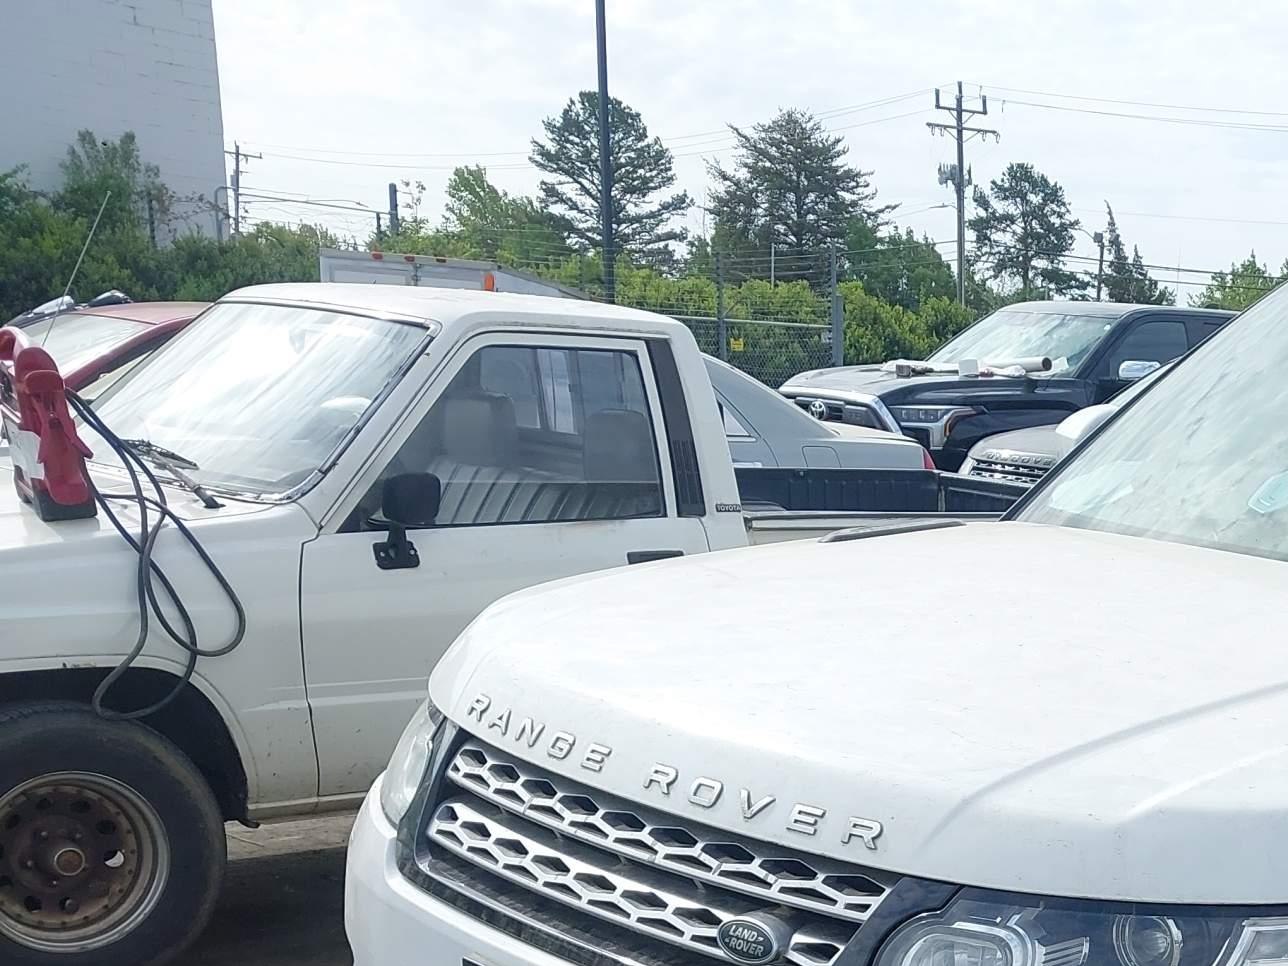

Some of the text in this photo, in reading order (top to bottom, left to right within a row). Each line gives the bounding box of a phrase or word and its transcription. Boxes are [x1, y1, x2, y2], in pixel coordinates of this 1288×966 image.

[716, 504, 741, 512] TOYOTA
[468, 693, 884, 850] RANGE ROVER
[729, 925, 757, 942] LAND
[729, 938, 764, 957] ROVER
